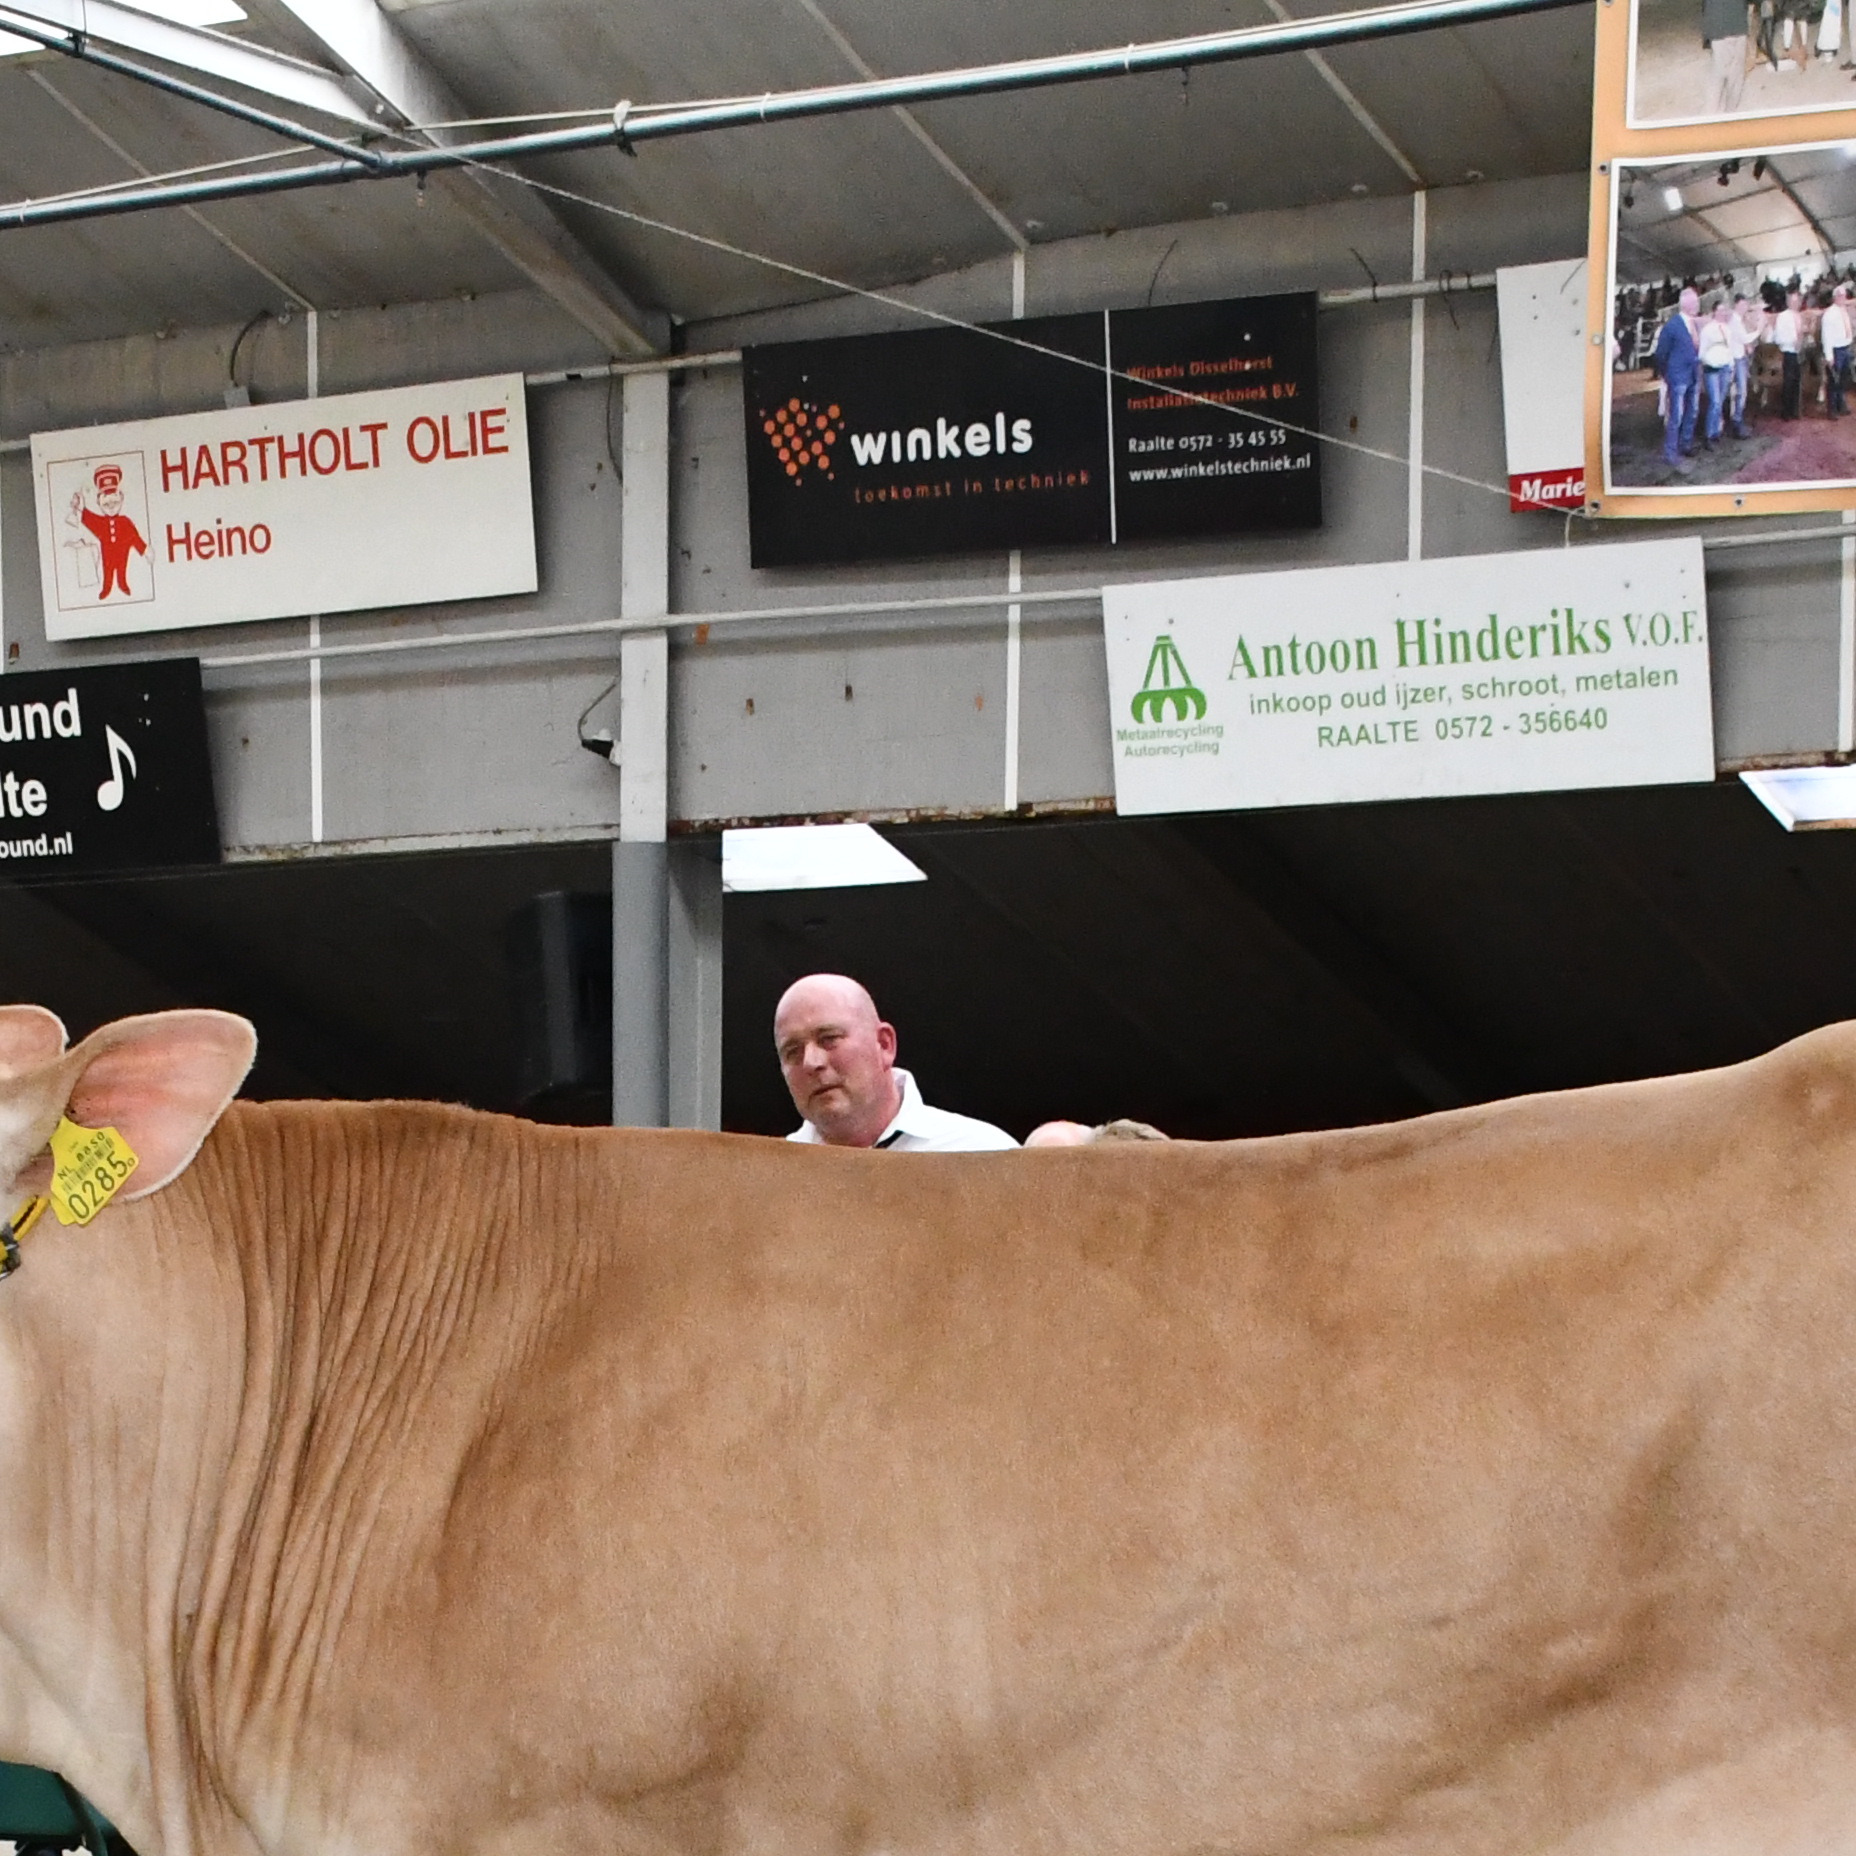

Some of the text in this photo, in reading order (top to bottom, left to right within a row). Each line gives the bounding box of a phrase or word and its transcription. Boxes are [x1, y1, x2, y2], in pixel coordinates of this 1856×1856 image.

[160, 408, 510, 493] HARTHOLT OLIE
[850, 411, 1033, 466] winkels
[1128, 435, 1175, 453] Raalte
[1178, 434, 1213, 451] 0572
[1228, 432, 1244, 449] 35
[1248, 430, 1266, 447] 45
[1270, 428, 1286, 446] 55
[1128, 453, 1312, 482] www.winkelstechniek.nl
[1519, 476, 1585, 502] Marie
[166, 518, 272, 563] Heino
[1227, 607, 1704, 682] Antoon Hinderiks V.O.F.
[1249, 667, 1679, 718] inkoop oud ijzer, schroot, metalen
[1317, 721, 1420, 748] RAALTE
[1434, 715, 1494, 742] 0572
[1519, 708, 1609, 735] 356640
[67, 1150, 129, 1219] 0285
